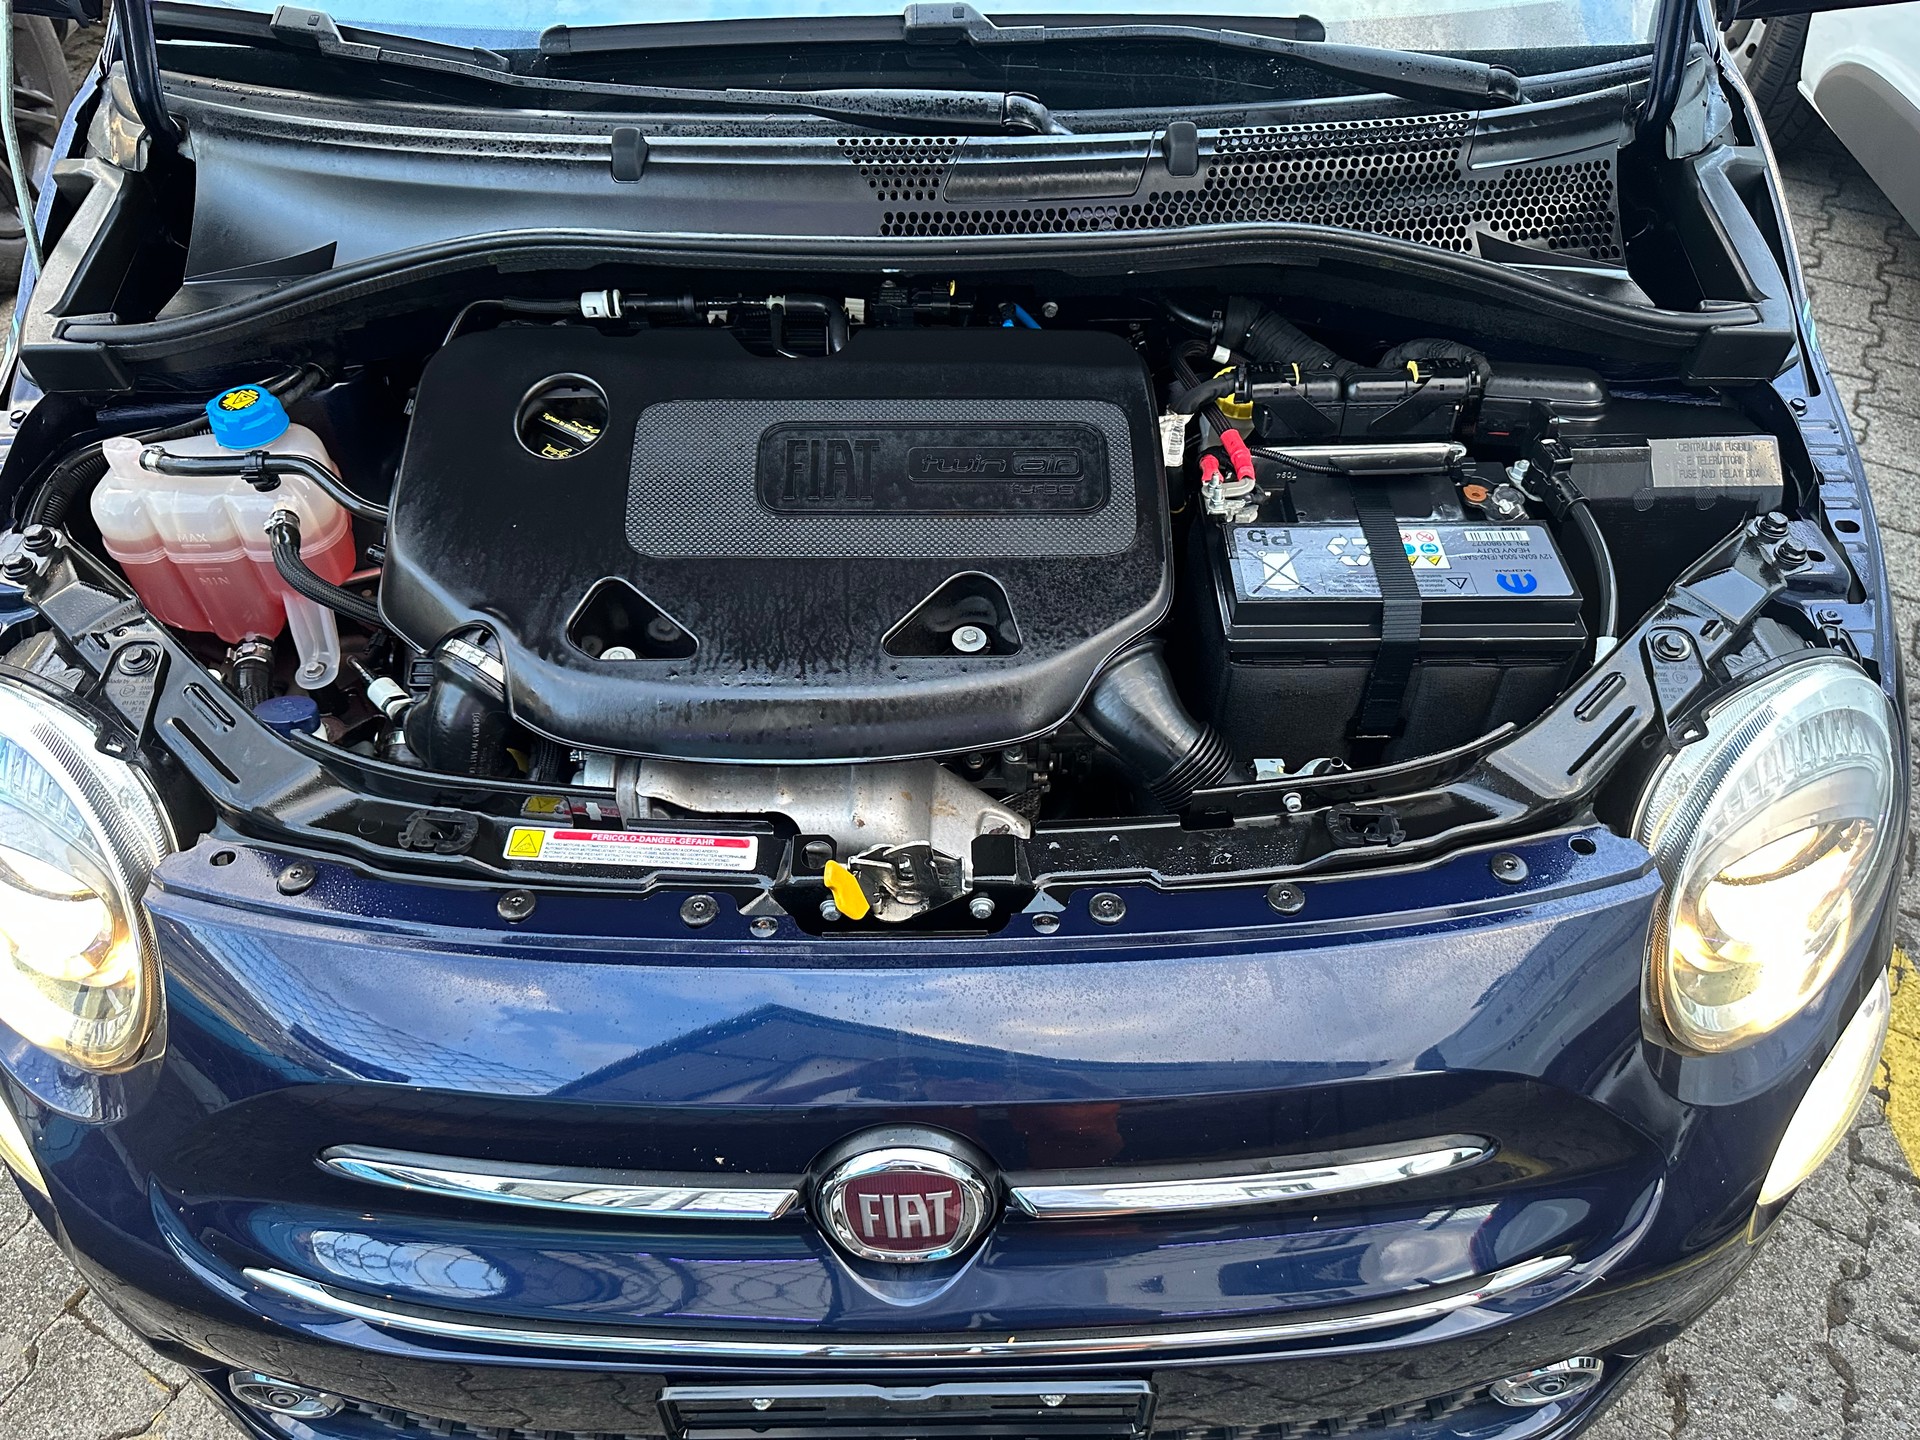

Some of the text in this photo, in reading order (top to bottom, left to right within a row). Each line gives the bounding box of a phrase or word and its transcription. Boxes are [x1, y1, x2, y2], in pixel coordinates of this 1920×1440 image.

[782, 438, 880, 500] FIAT
[921, 453, 1072, 473] twin air
[1679, 468, 1760, 479] FUSE AND RELAY BOX
[177, 533, 208, 542] MAX
[1247, 529, 1293, 547] Pb
[199, 576, 230, 586] MIN
[591, 833, 715, 846] PERICOLO-DANGER-GEFAHR
[858, 1190, 952, 1238] FIAT
